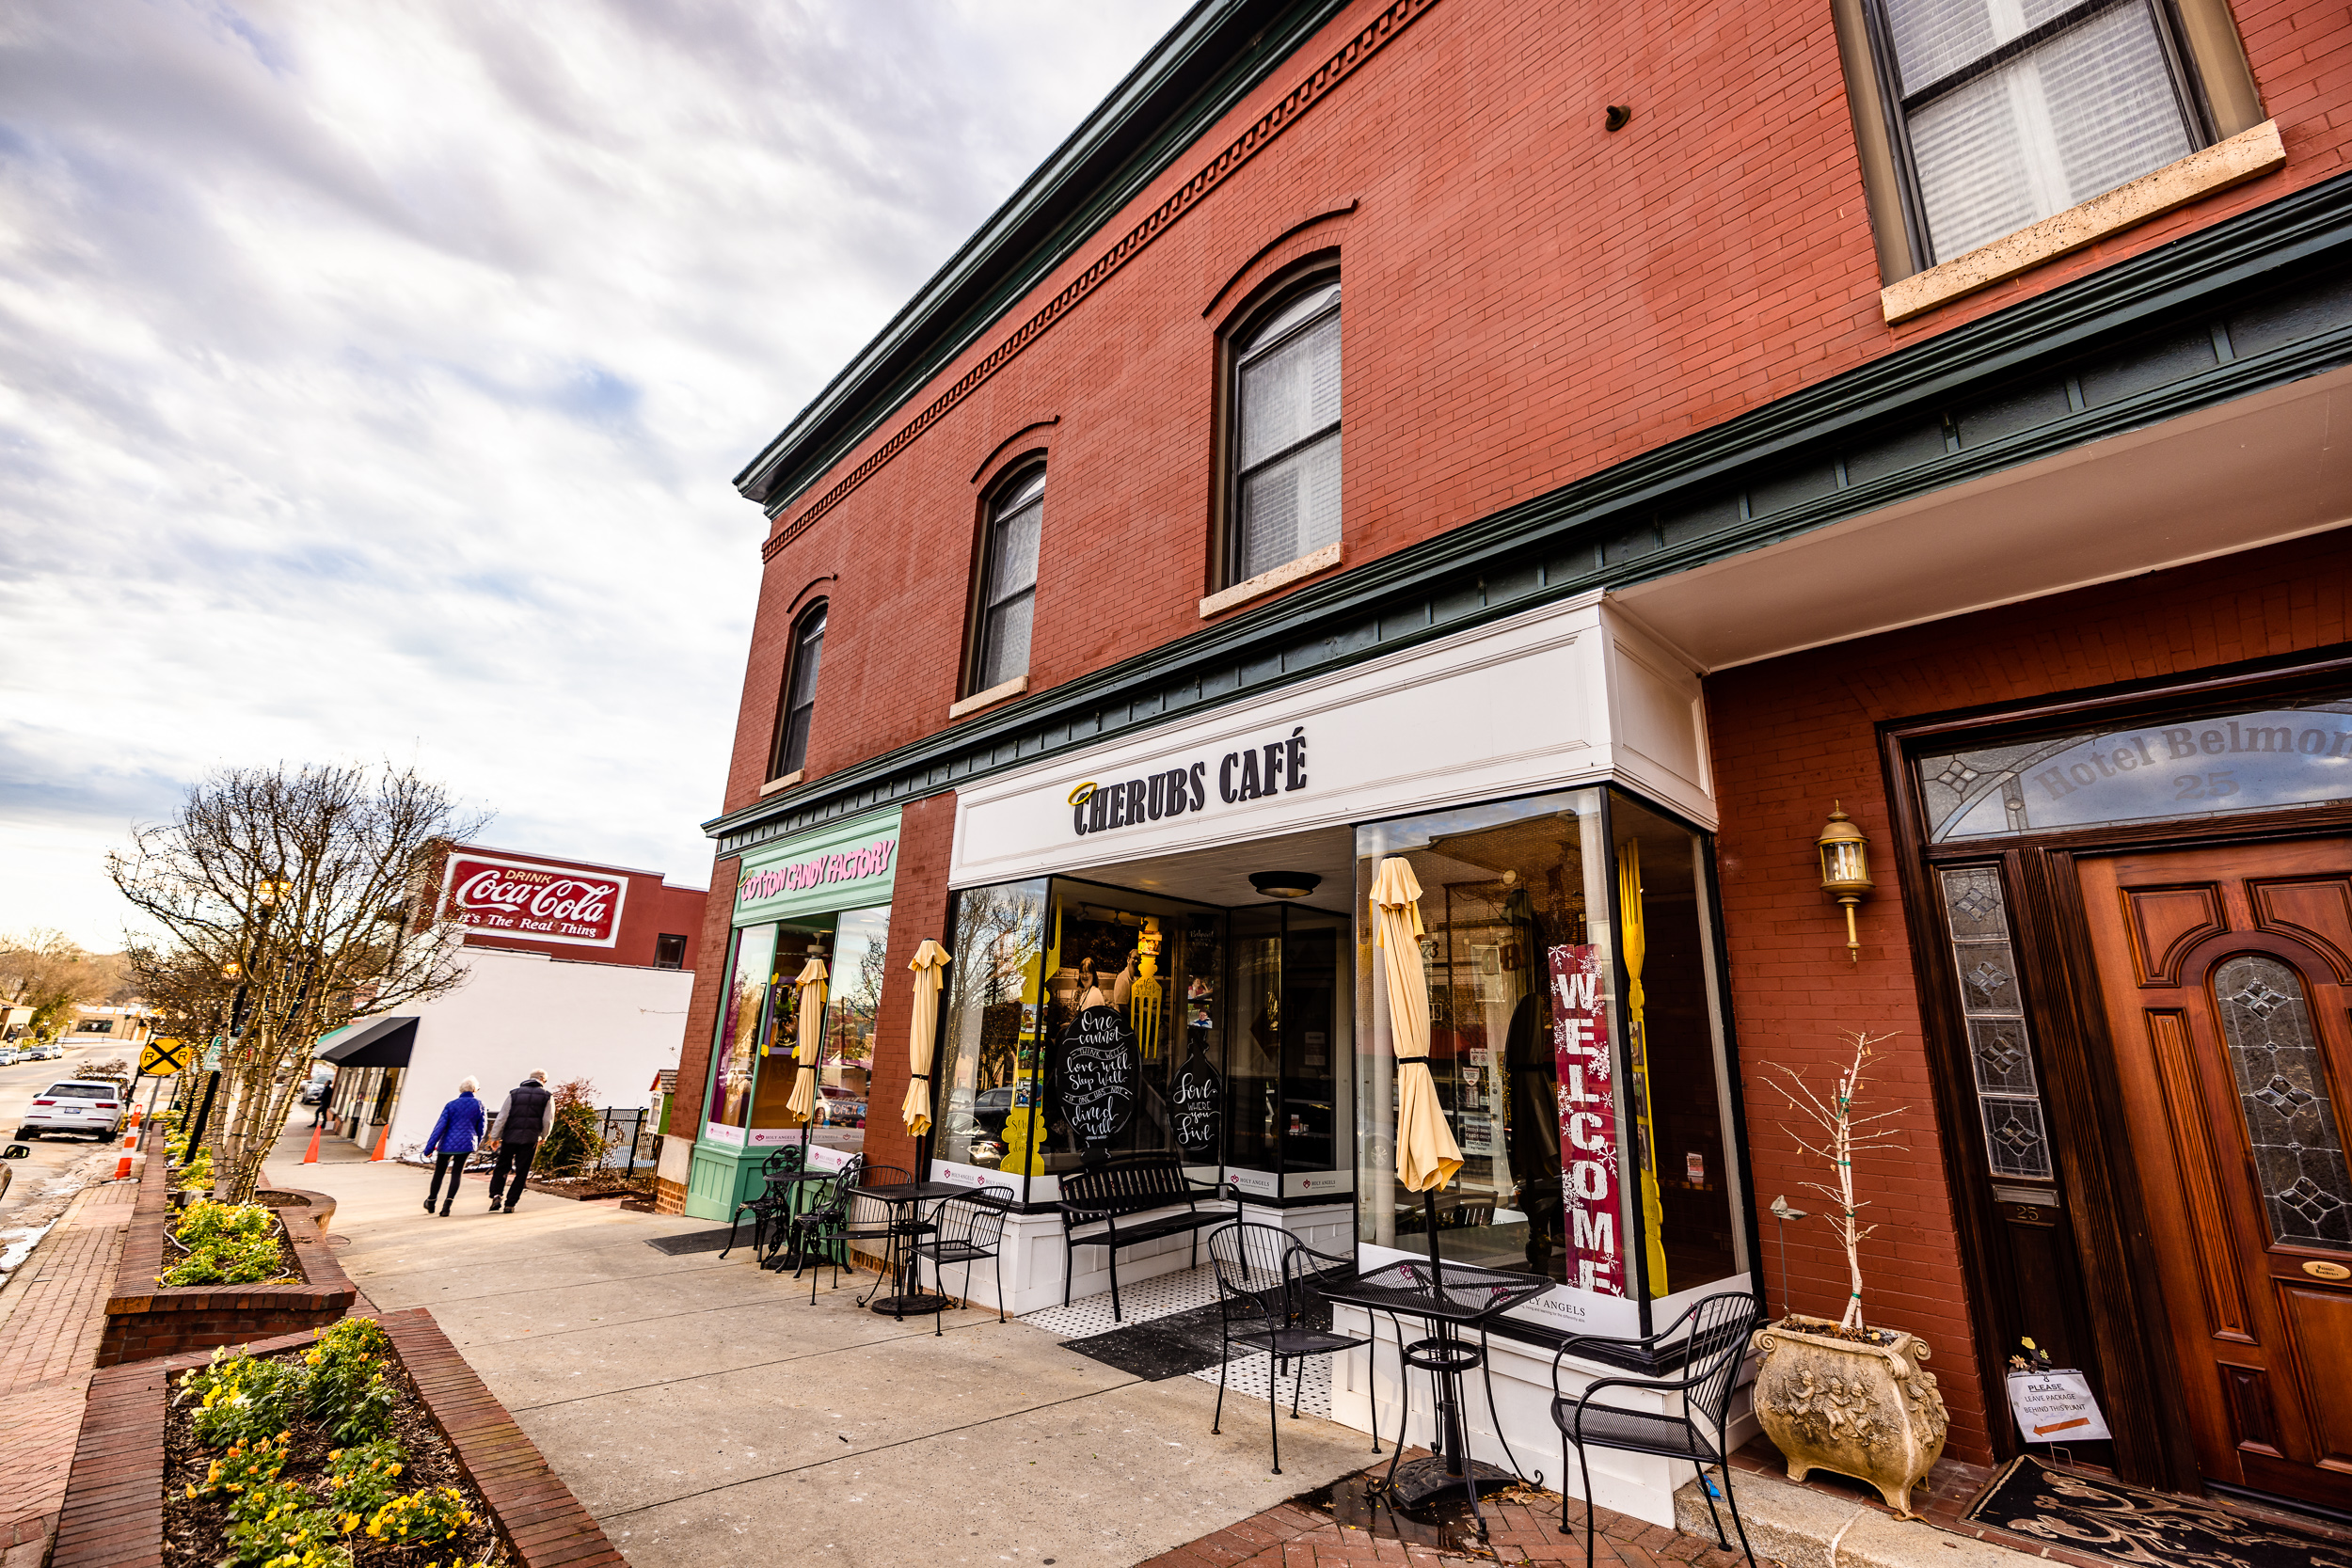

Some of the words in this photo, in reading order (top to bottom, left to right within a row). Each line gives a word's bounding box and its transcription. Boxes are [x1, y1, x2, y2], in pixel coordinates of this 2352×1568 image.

[2033, 736, 2155, 801] Hotel
[1073, 761, 1205, 835] CHERUBS
[1219, 726, 1308, 804] CAFÉ
[2172, 770, 2240, 801] 25
[504, 870, 553, 884] DRINK
[740, 866, 787, 901] COTTON
[787, 854, 829, 891] CANDY
[827, 839, 896, 883] FACTORY
[455, 870, 615, 922] Coca-Cola
[488, 914, 514, 927] The
[519, 918, 554, 932] Real
[560, 922, 597, 938] Thing
[1081, 1011, 1122, 1032] One
[1072, 1026, 1127, 1044] cannot
[144, 1052, 154, 1061] R
[178, 1051, 188, 1060] R
[1079, 1048, 1102, 1059] THINK
[1104, 1048, 1120, 1060] WELL
[1064, 1056, 1098, 1073] love
[1093, 1088, 1106, 1099] HAS
[1173, 1072, 1217, 1103] Love
[834, 1104, 858, 1115] OPEN
[1072, 1096, 1119, 1126] dined
[1187, 1101, 1212, 1111] WHERE
[1079, 1118, 1116, 1134] well
[1184, 1111, 1214, 1124] you
[1177, 1117, 1215, 1144] Live
[1556, 973, 1614, 1293] WELCOME
[1252, 1179, 1270, 1187] ANGELS
[2016, 1205, 2039, 1221] 25
[1543, 1299, 1585, 1317] ANGELS
[2027, 1383, 2063, 1391] PLEASE
